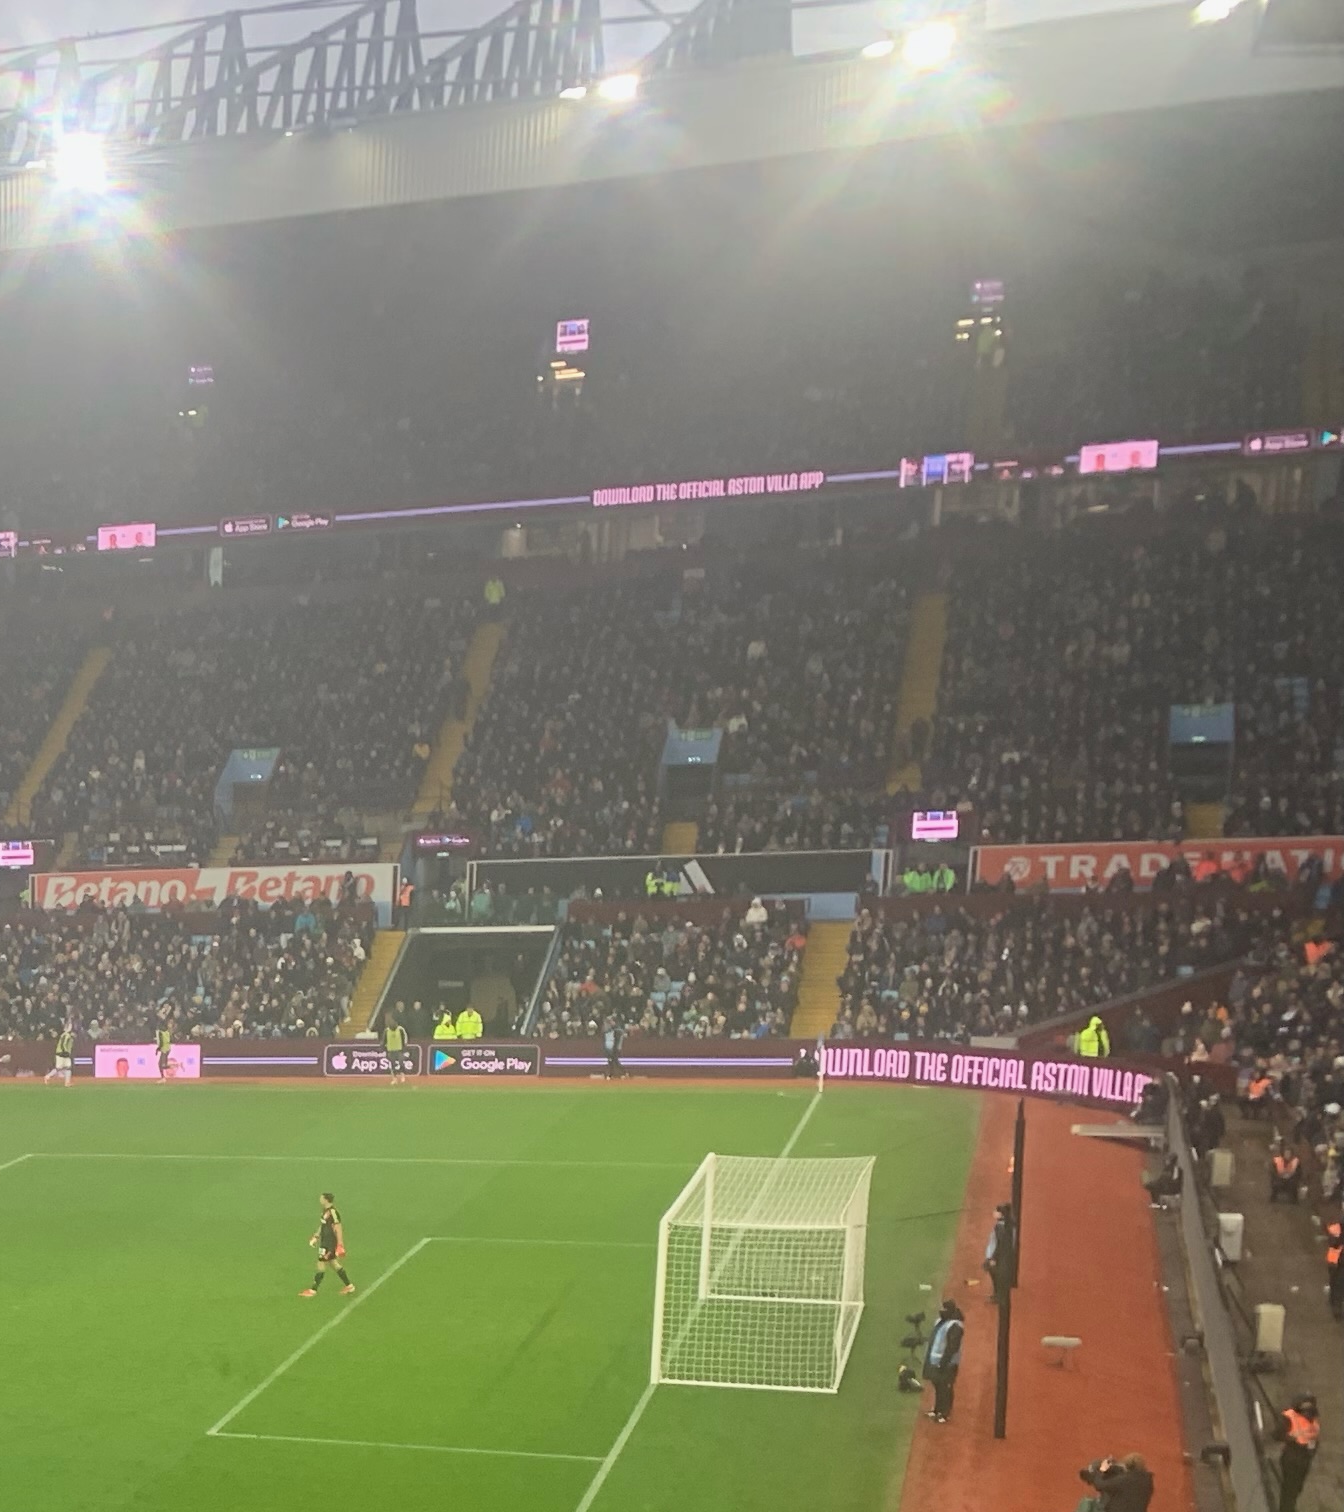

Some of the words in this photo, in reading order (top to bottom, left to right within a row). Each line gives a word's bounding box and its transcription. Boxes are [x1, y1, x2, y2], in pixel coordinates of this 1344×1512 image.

[593, 486, 654, 507] DOWNLOAD
[656, 483, 677, 501] THE
[679, 479, 726, 500] OFFICIAL
[728, 476, 764, 496] ASTON
[766, 473, 798, 492] VILLA
[799, 471, 824, 490] APP
[44, 876, 188, 909] Betano
[352, 1059, 378, 1072] App
[461, 1058, 505, 1073] Google
[506, 1058, 532, 1073] Play
[812, 1047, 910, 1079] OWNLOAD
[914, 1051, 948, 1081] THE
[951, 1054, 1027, 1089] OFFICIAL
[1092, 1066, 1132, 1102] VILLA
